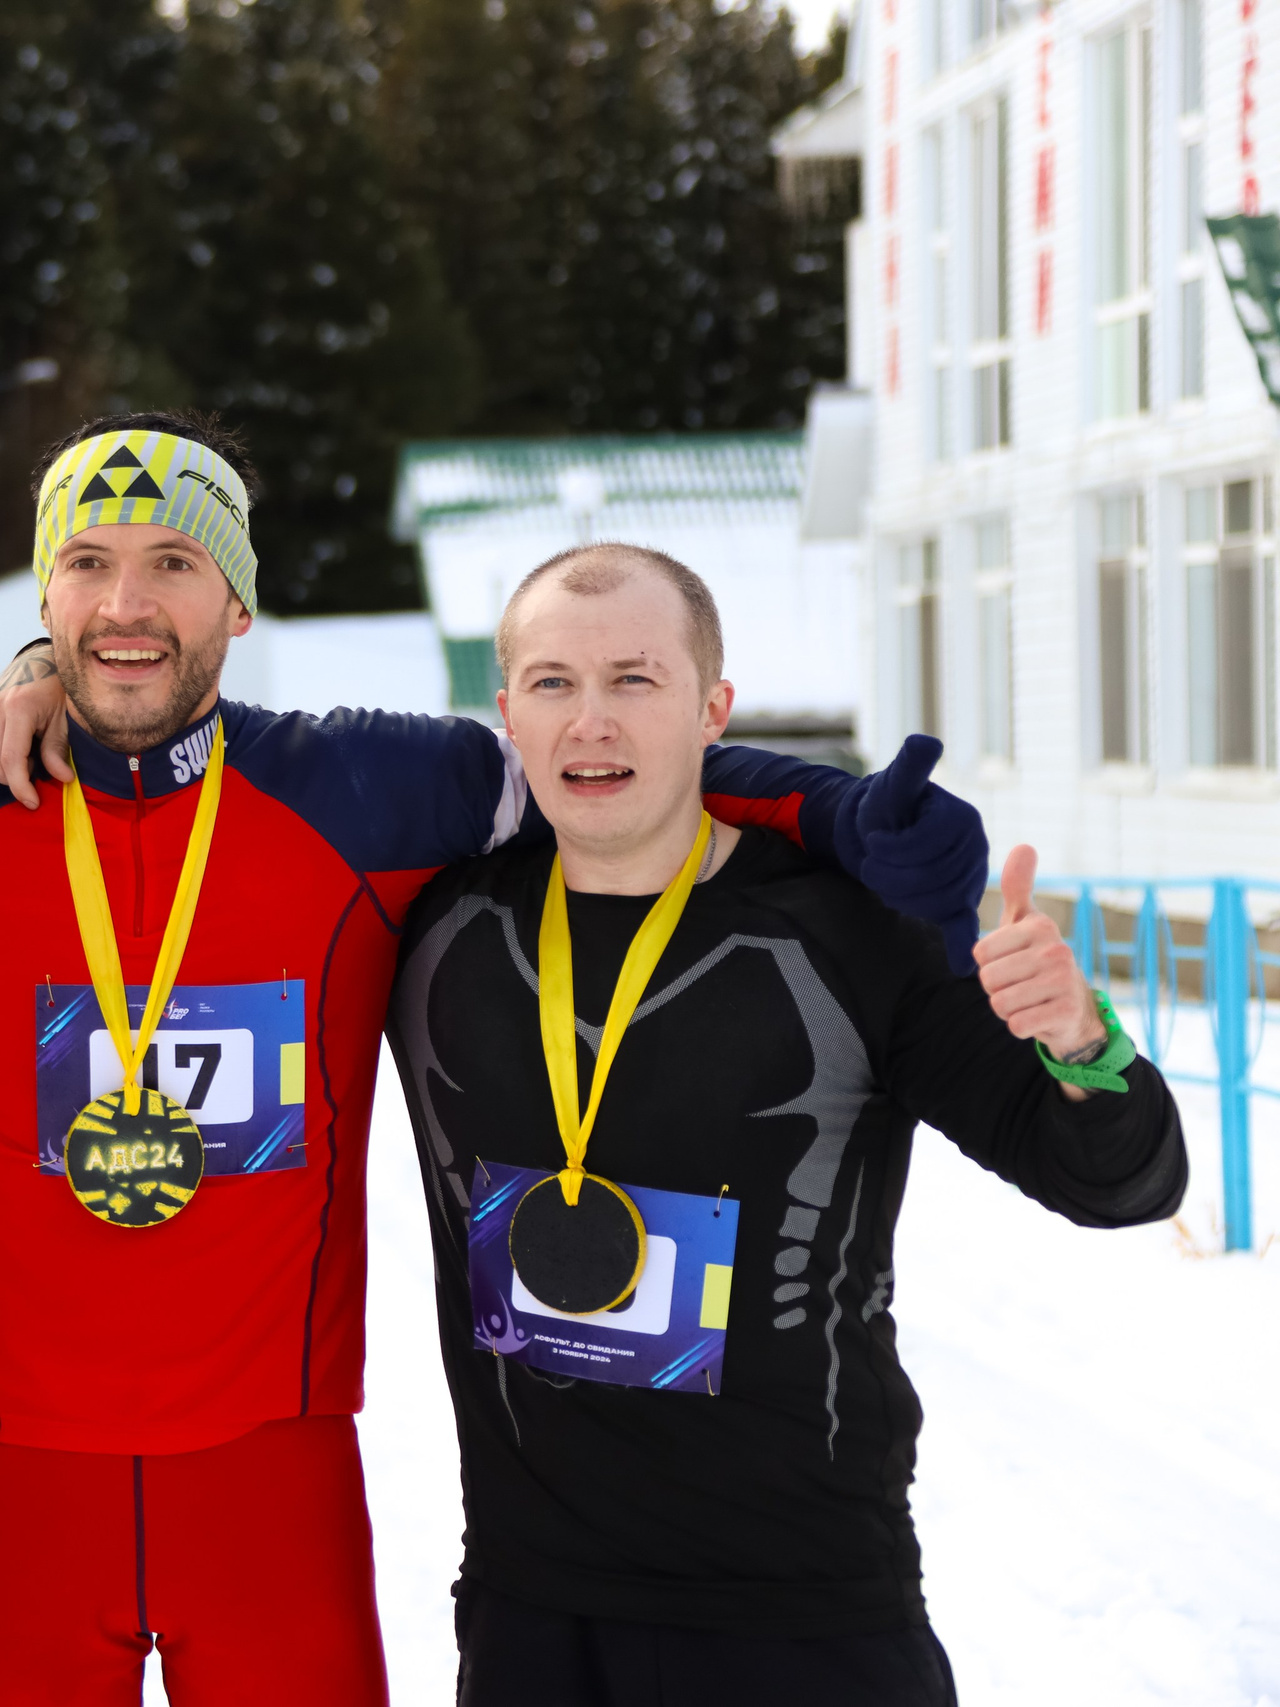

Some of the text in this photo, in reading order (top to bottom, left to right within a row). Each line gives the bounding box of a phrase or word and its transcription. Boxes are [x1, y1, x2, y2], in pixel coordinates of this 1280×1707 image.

[84, 1140, 184, 1175] АДС24
[534, 1334, 572, 1347] АСФАЛЬТ,
[587, 1345, 635, 1357] СВИДАНИЯ
[559, 1349, 589, 1360] НОЯБРЯ
[590, 1355, 611, 1363] 2024
